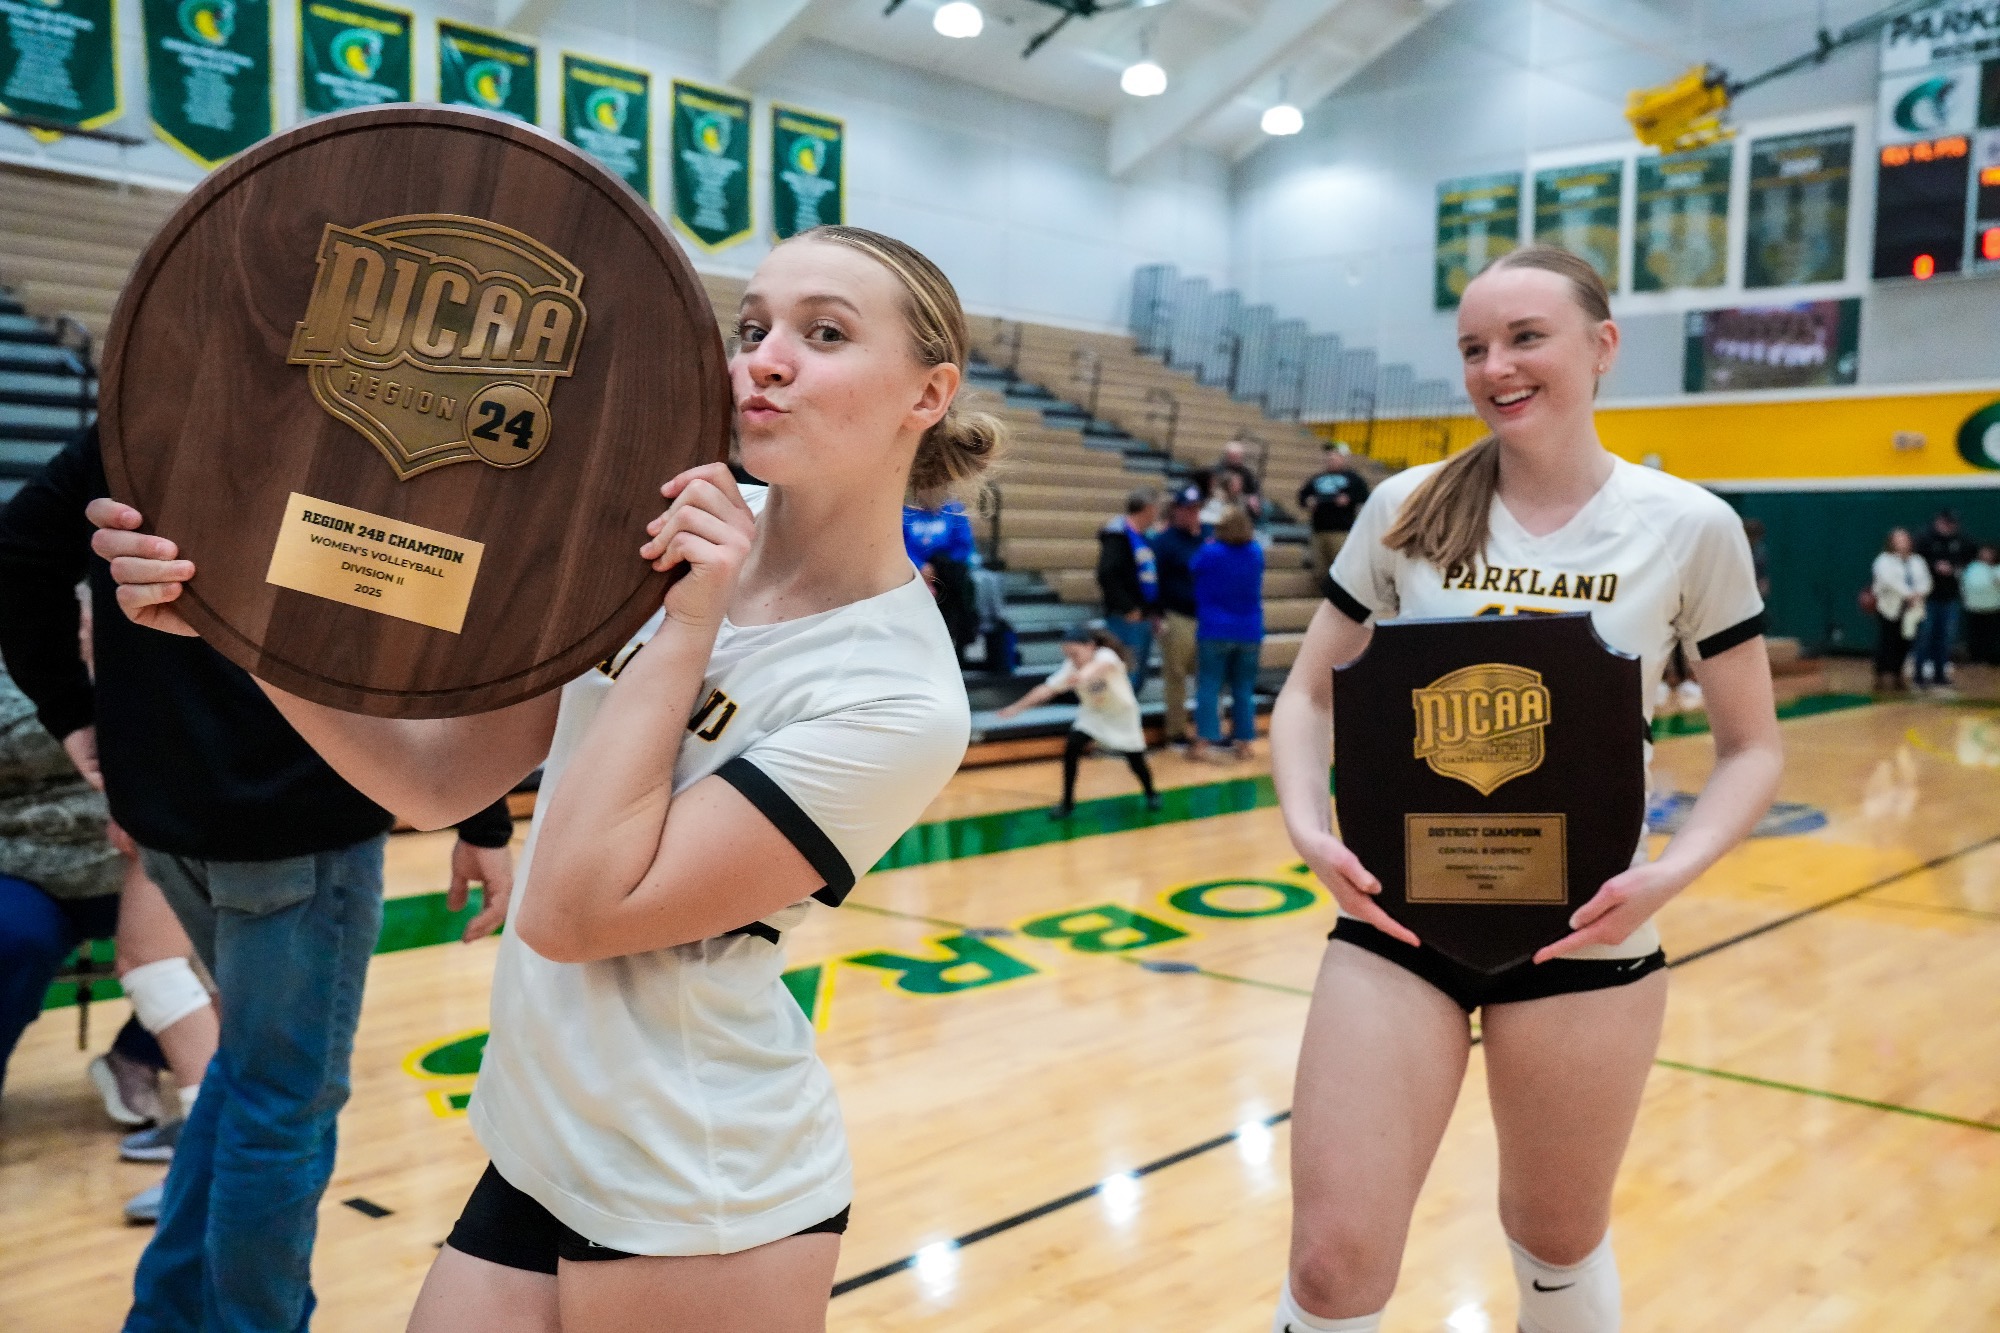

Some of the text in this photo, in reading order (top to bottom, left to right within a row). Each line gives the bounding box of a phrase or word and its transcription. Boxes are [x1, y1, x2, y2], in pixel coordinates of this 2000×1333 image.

[298, 240, 574, 364] NJCAA
[344, 370, 536, 450] REGION 24
[302, 510, 465, 564] REGION 24B CHAMPION
[310, 533, 445, 578] WOMEN'S VOLLEYBALL
[341, 561, 405, 586] DIVISION II
[354, 583, 383, 598] 2025
[1441, 564, 1619, 603] PARKLAND
[1414, 688, 1545, 752] NJCAA
